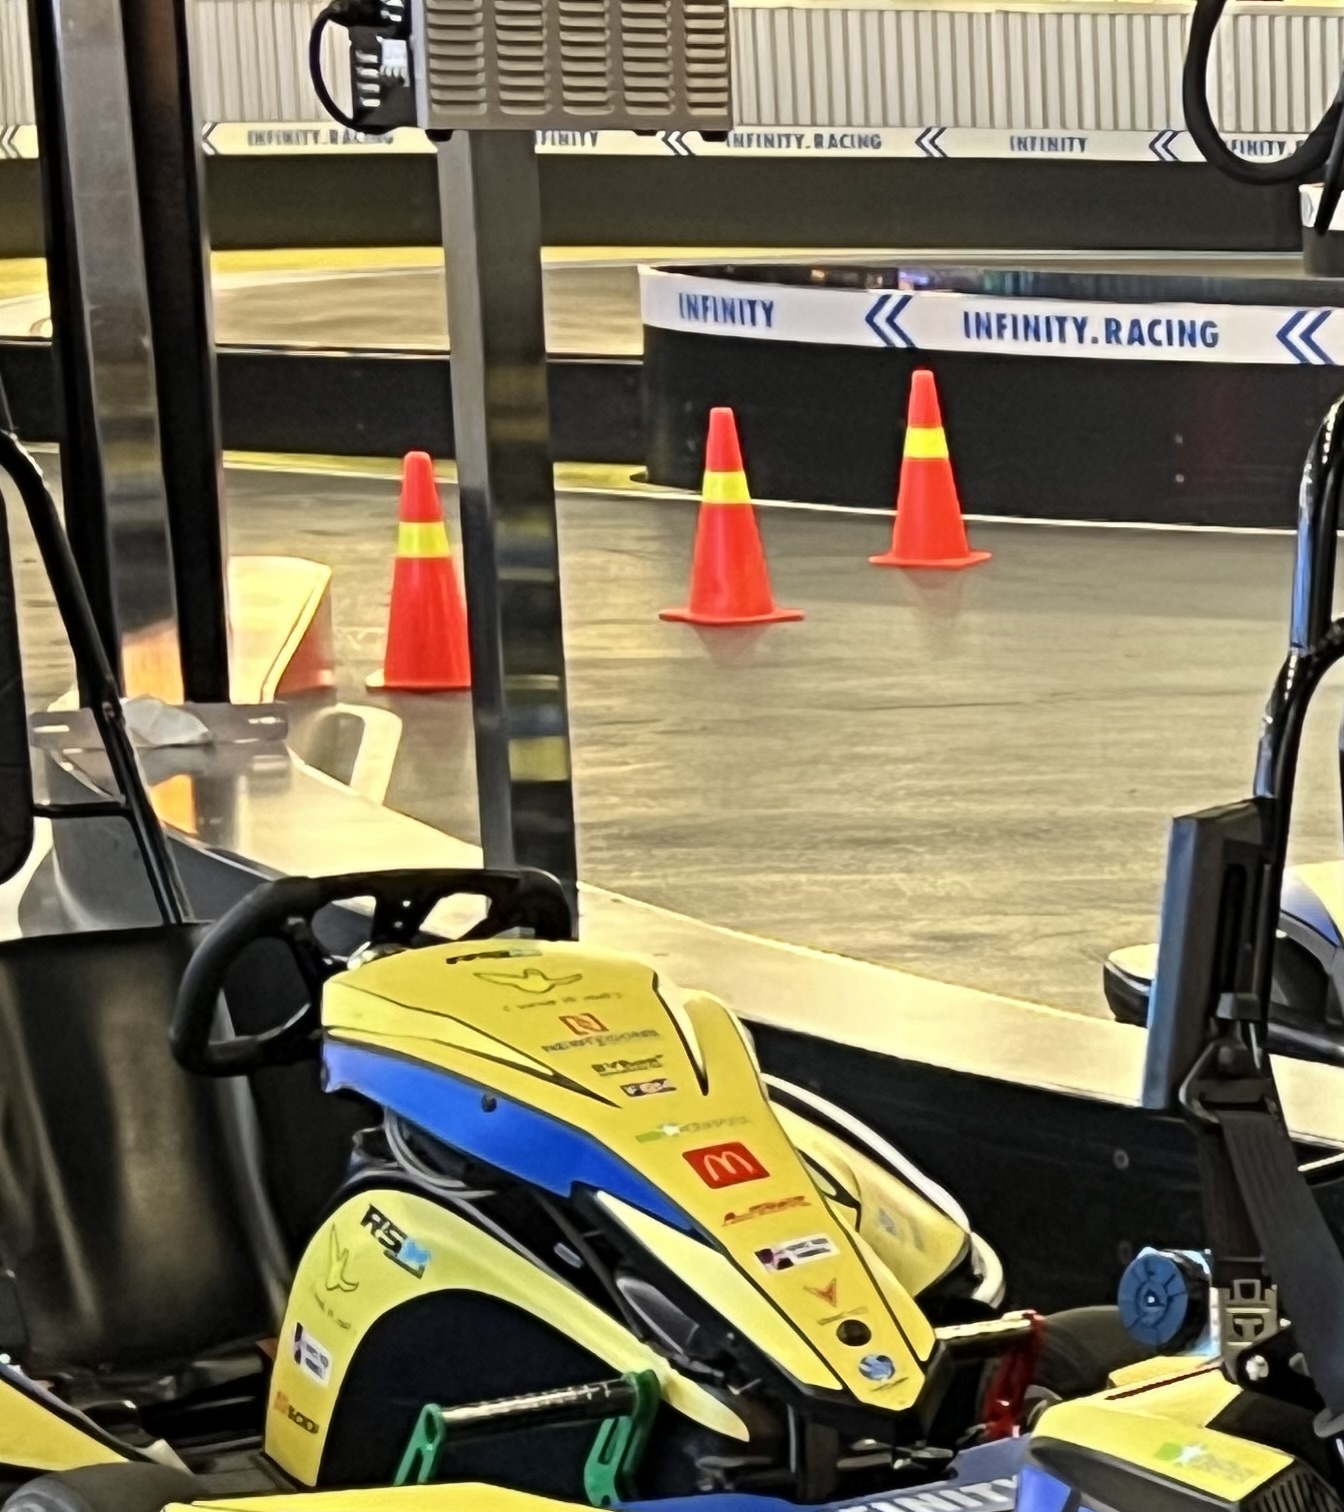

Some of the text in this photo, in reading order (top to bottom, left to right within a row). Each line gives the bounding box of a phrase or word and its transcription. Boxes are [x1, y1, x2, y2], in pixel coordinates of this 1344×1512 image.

[1010, 136, 1088, 152] INFINITY
[678, 293, 775, 329] INFINITY
[963, 310, 1219, 349] INFINITY.RACING
